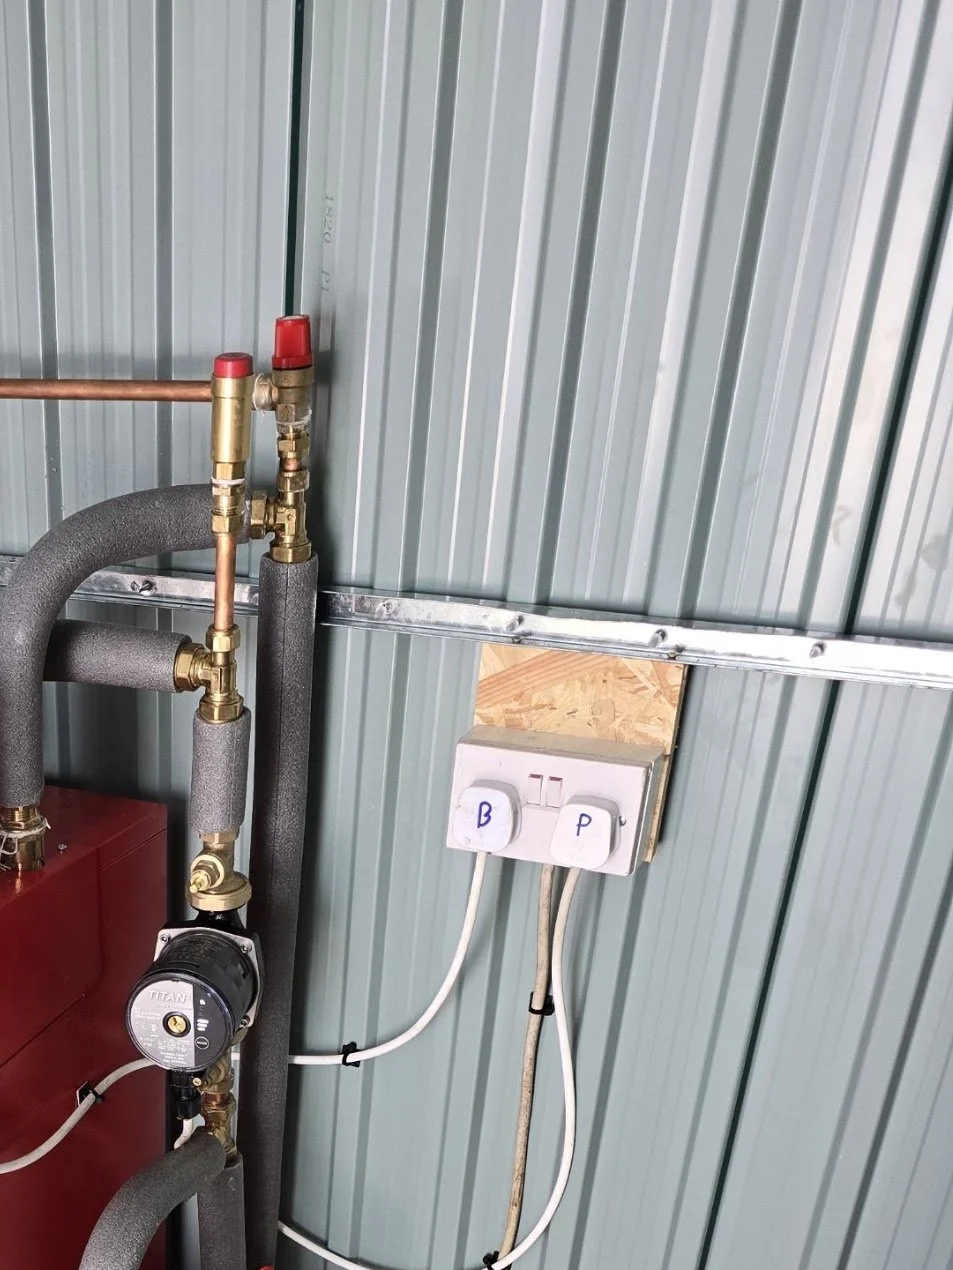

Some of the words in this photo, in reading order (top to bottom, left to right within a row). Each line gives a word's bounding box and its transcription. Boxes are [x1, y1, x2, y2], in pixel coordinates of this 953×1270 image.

[476, 800, 494, 829] B
[576, 812, 593, 837] P
[148, 988, 188, 1003] TITAN
